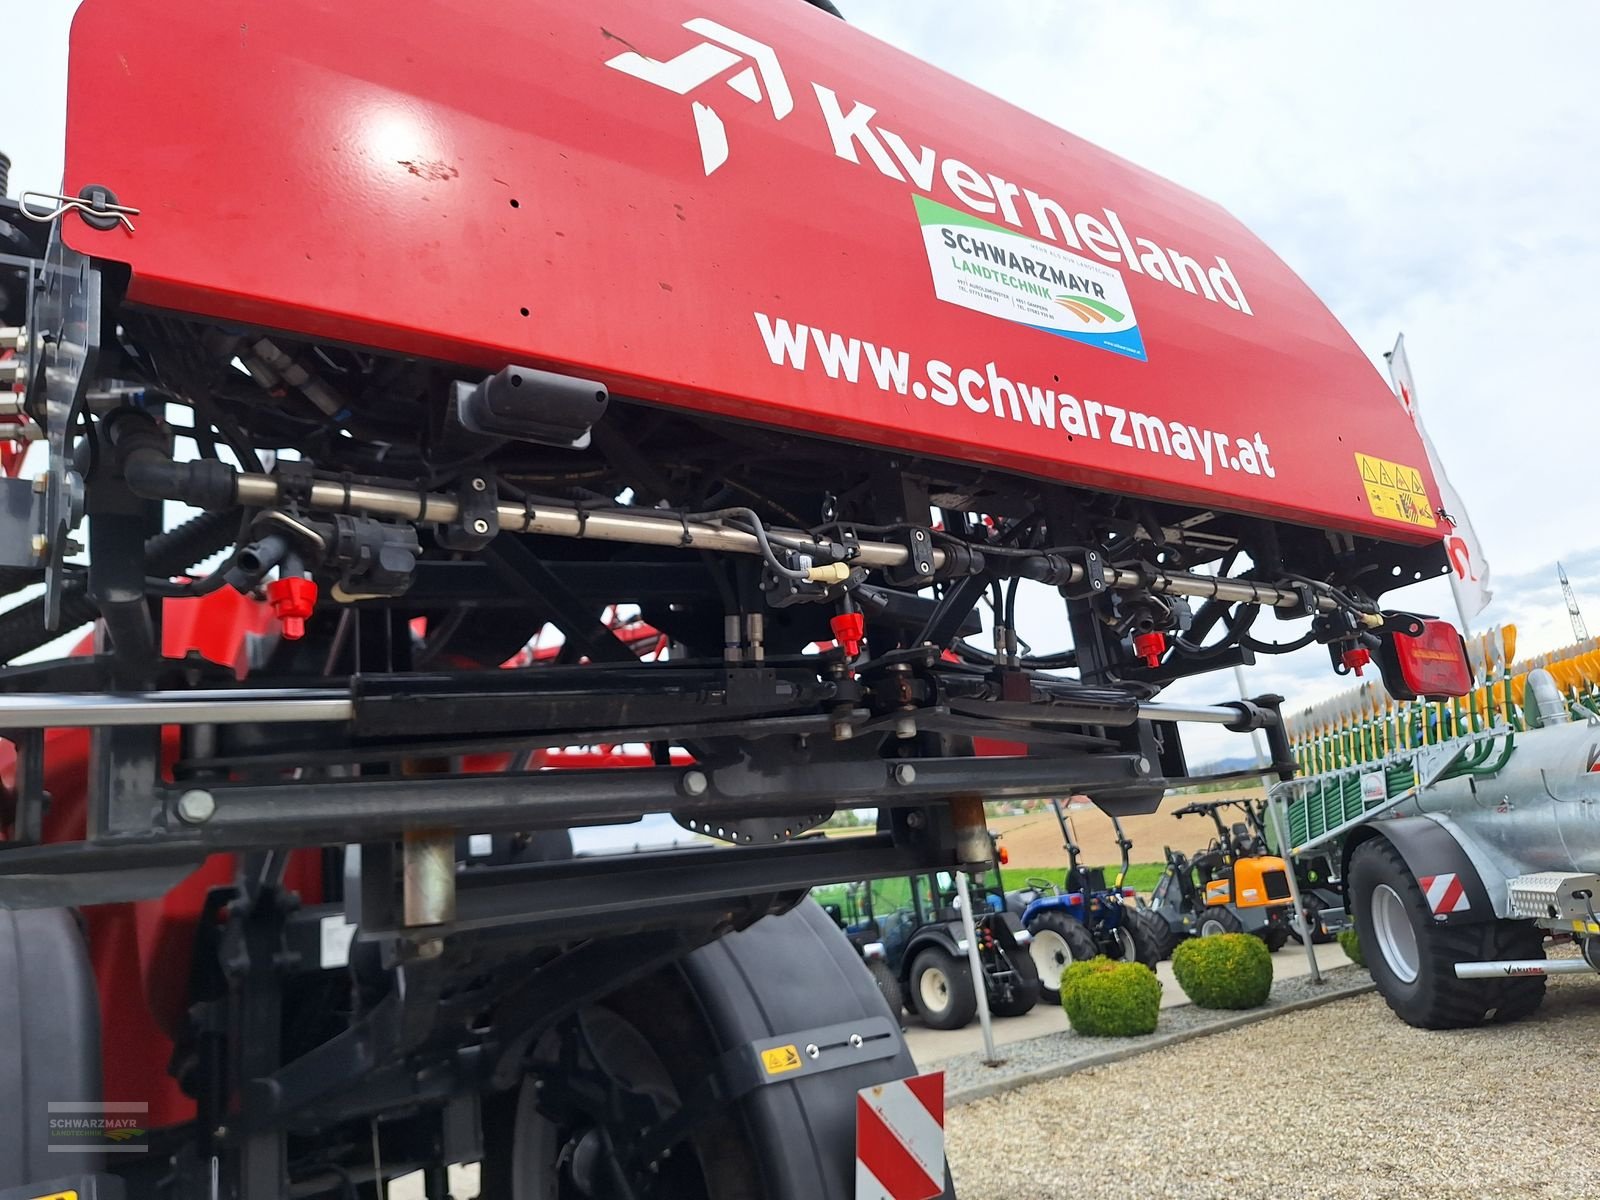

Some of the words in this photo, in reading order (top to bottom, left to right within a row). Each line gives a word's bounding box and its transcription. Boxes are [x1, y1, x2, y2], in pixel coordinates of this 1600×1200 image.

[811, 81, 1254, 317] Kverneland
[941, 227, 1106, 300] SCHWARZMAYR
[951, 256, 1053, 300] LANDTECHNIK
[753, 312, 1276, 478] www.schwarzmayr.at
